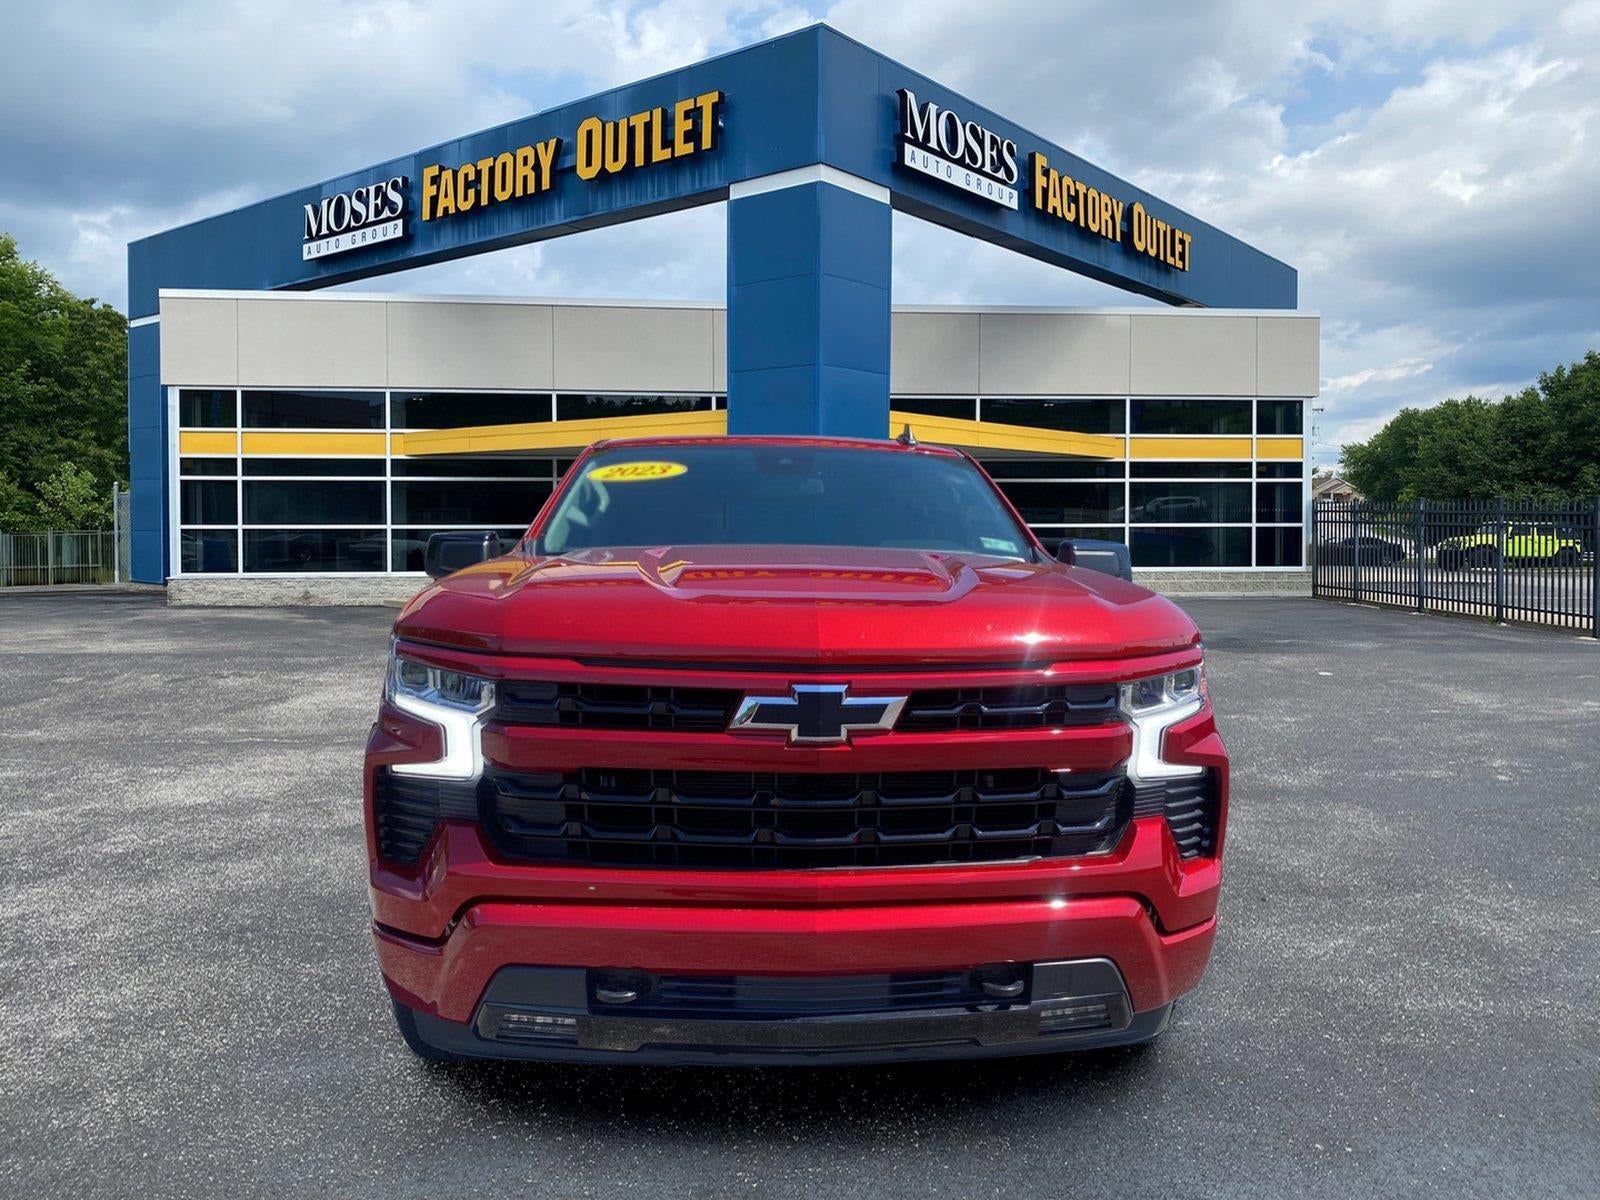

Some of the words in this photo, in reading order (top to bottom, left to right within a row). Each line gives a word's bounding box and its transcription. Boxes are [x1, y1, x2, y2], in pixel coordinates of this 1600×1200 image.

[421, 137, 559, 222] FACTORY
[576, 91, 720, 181] OUTLET
[903, 88, 1018, 184] MOSES
[303, 176, 404, 240] MOSES
[910, 150, 952, 178] AUTO
[965, 173, 1014, 204] GROUP
[307, 240, 340, 256] AUTO
[351, 223, 399, 245] GROUP
[1033, 151, 1124, 242] FACTORY
[1132, 202, 1192, 272] OUTLET
[603, 464, 673, 478] 2023
